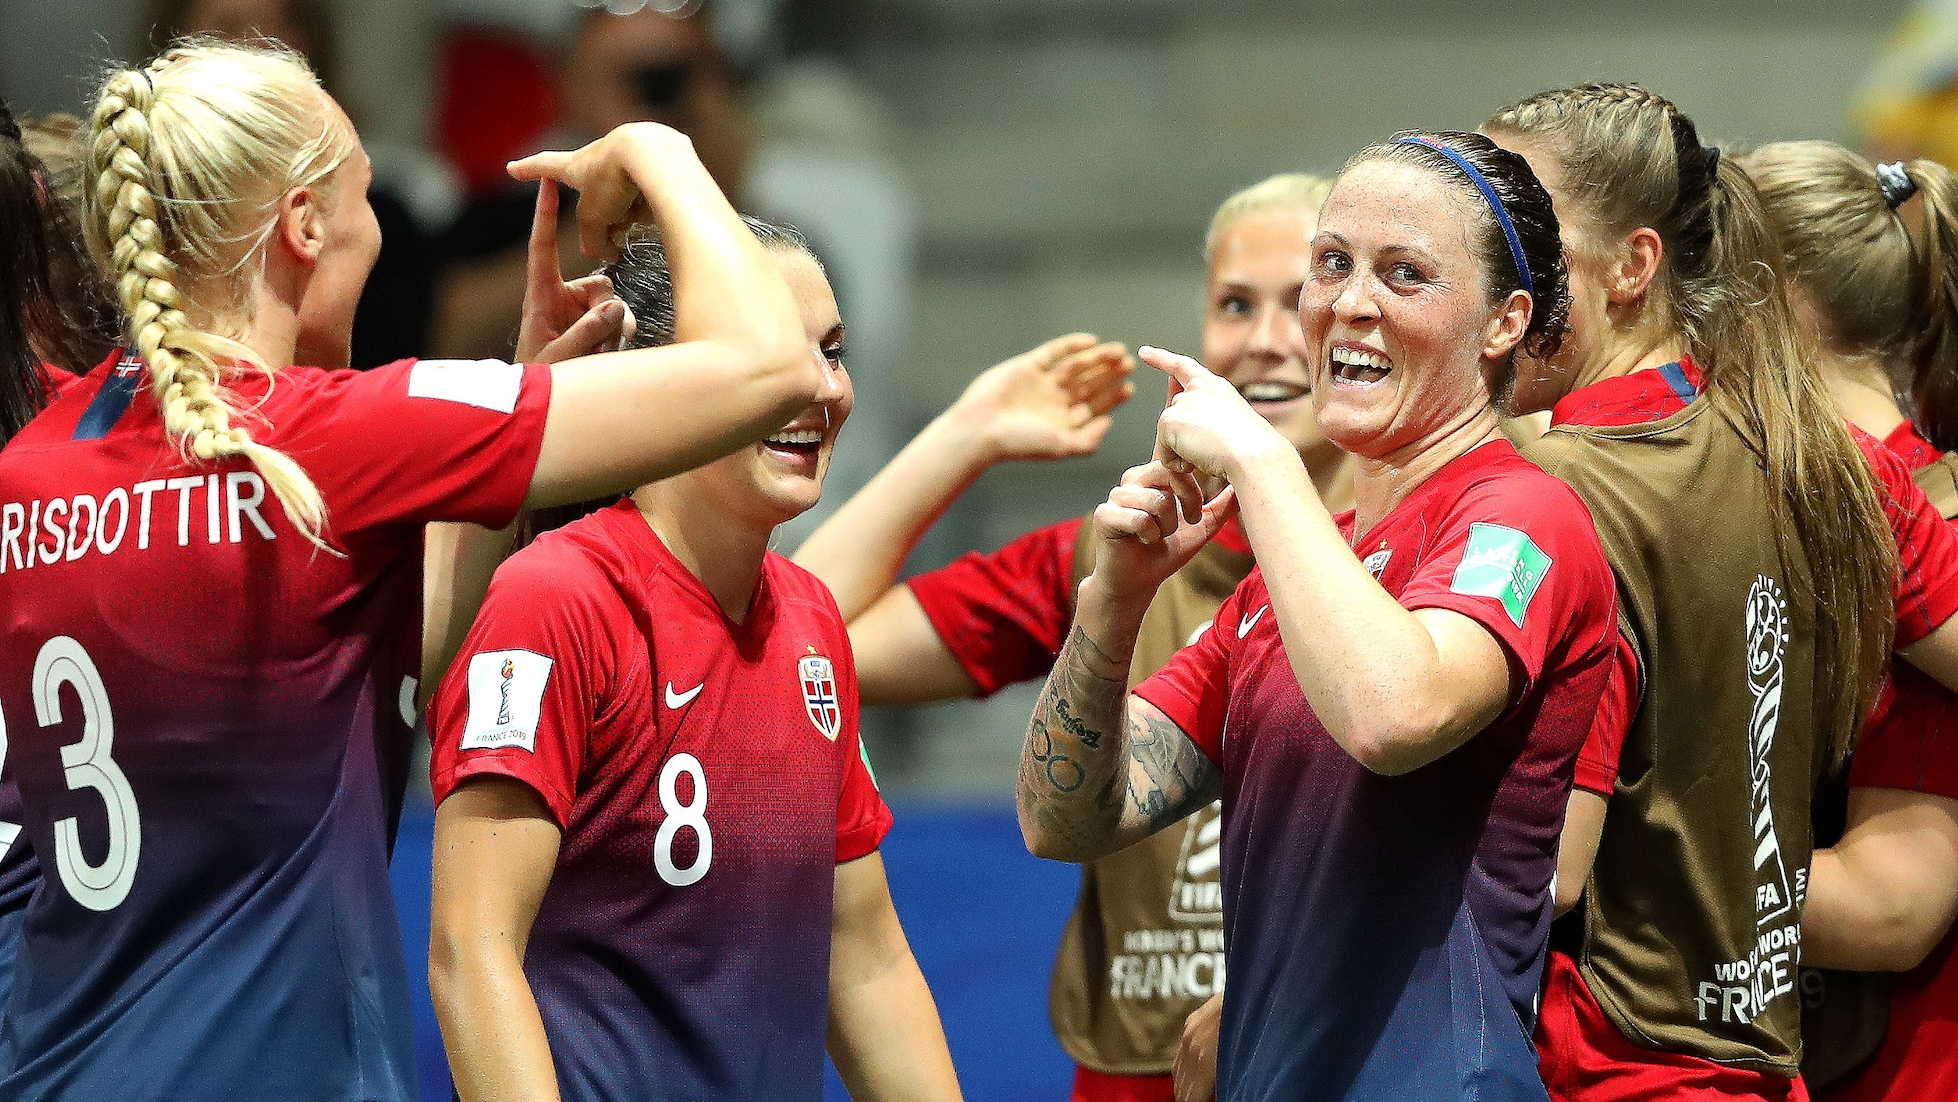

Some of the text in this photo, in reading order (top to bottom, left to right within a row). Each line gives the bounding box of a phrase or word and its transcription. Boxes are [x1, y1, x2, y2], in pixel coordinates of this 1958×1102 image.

[0, 471, 277, 574] RISDOTTIR
[31, 635, 141, 912] 3
[476, 730, 508, 742] FRANCE
[653, 752, 713, 887] 8
[1756, 882, 1781, 912] FA
